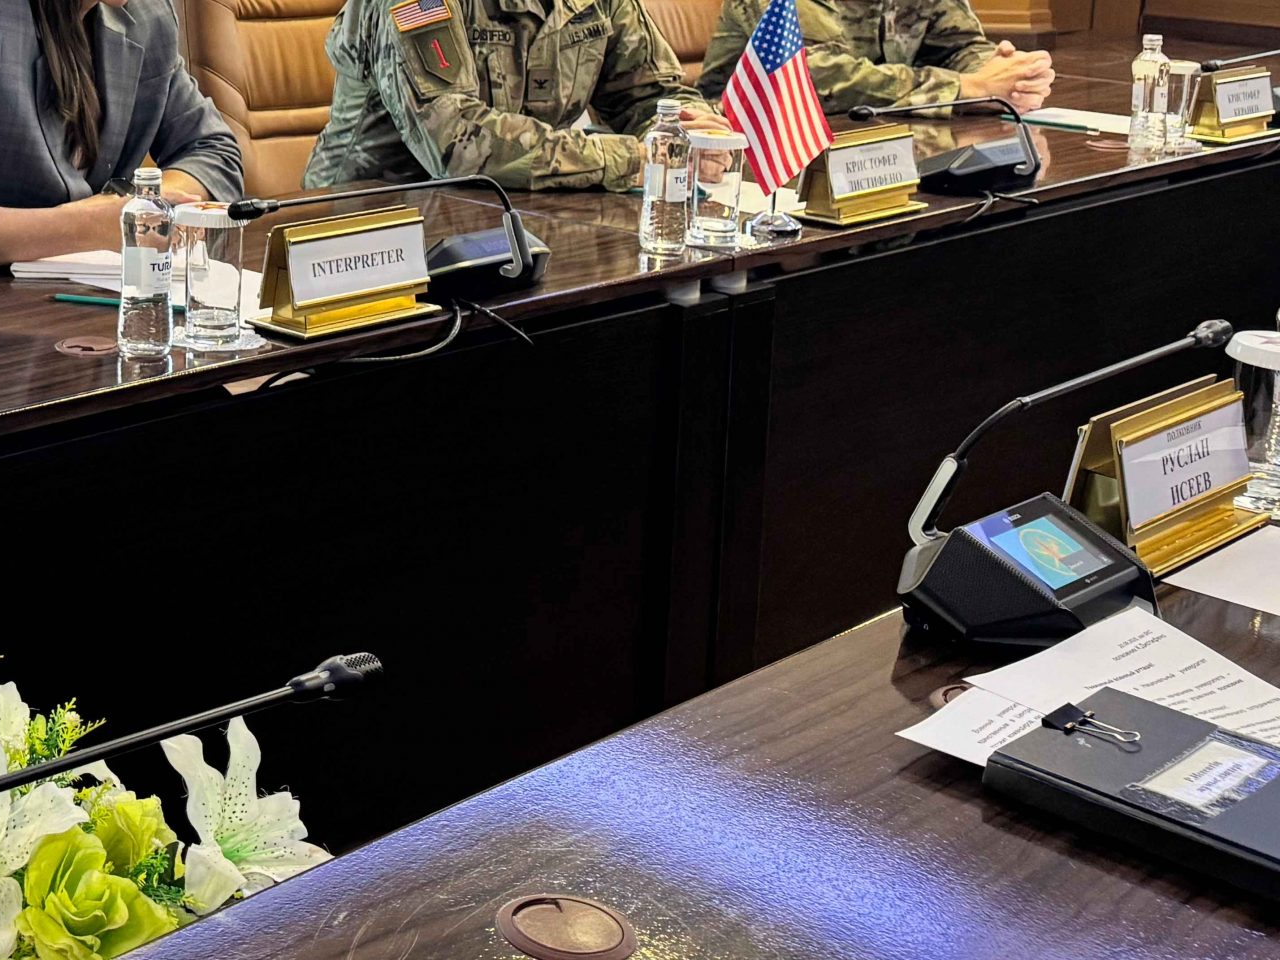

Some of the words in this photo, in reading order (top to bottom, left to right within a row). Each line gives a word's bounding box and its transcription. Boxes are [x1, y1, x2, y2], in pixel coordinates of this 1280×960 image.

[845, 153, 898, 174] КРИСТОФЕР
[312, 248, 405, 278] INTERPRETER
[1161, 437, 1210, 475] РУСЛАН
[1170, 471, 1212, 506] ИСЕЕВ
